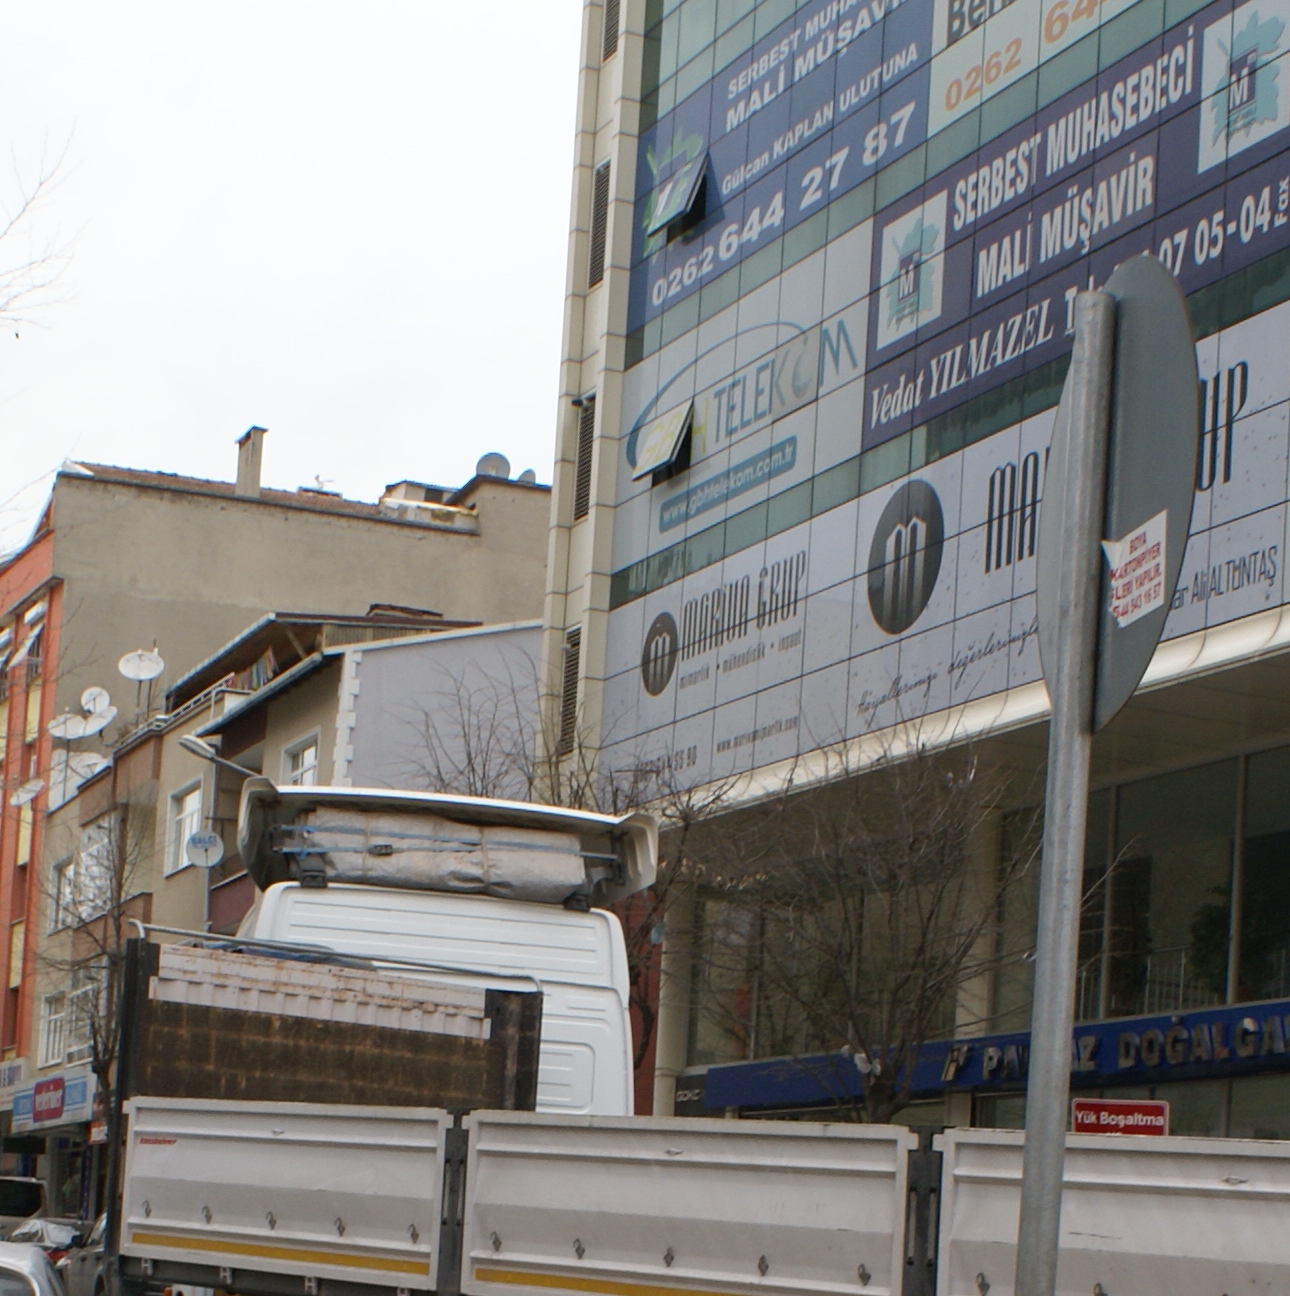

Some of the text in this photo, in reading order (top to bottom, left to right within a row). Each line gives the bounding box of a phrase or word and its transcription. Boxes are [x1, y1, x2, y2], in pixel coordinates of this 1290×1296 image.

[725, 65, 786, 132] MALİ
[727, 0, 858, 100] SERBEST MUHA
[944, 37, 1023, 112] 0262
[721, 41, 918, 195] Gülcan KAPLAN ULUTUNA
[953, 23, 1195, 232] SERBEST MUHASEBECİ
[651, 101, 916, 307] 0262 644 27 87
[975, 152, 1154, 299] MALİ MÜŞAVİR
[713, 318, 858, 444] TELEKOM
[870, 369, 925, 430] Vedat
[928, 298, 1055, 400] YILMAZEL
[757, 549, 806, 630] GRUP
[1075, 1109, 1165, 1129] Yük Boşaltma
